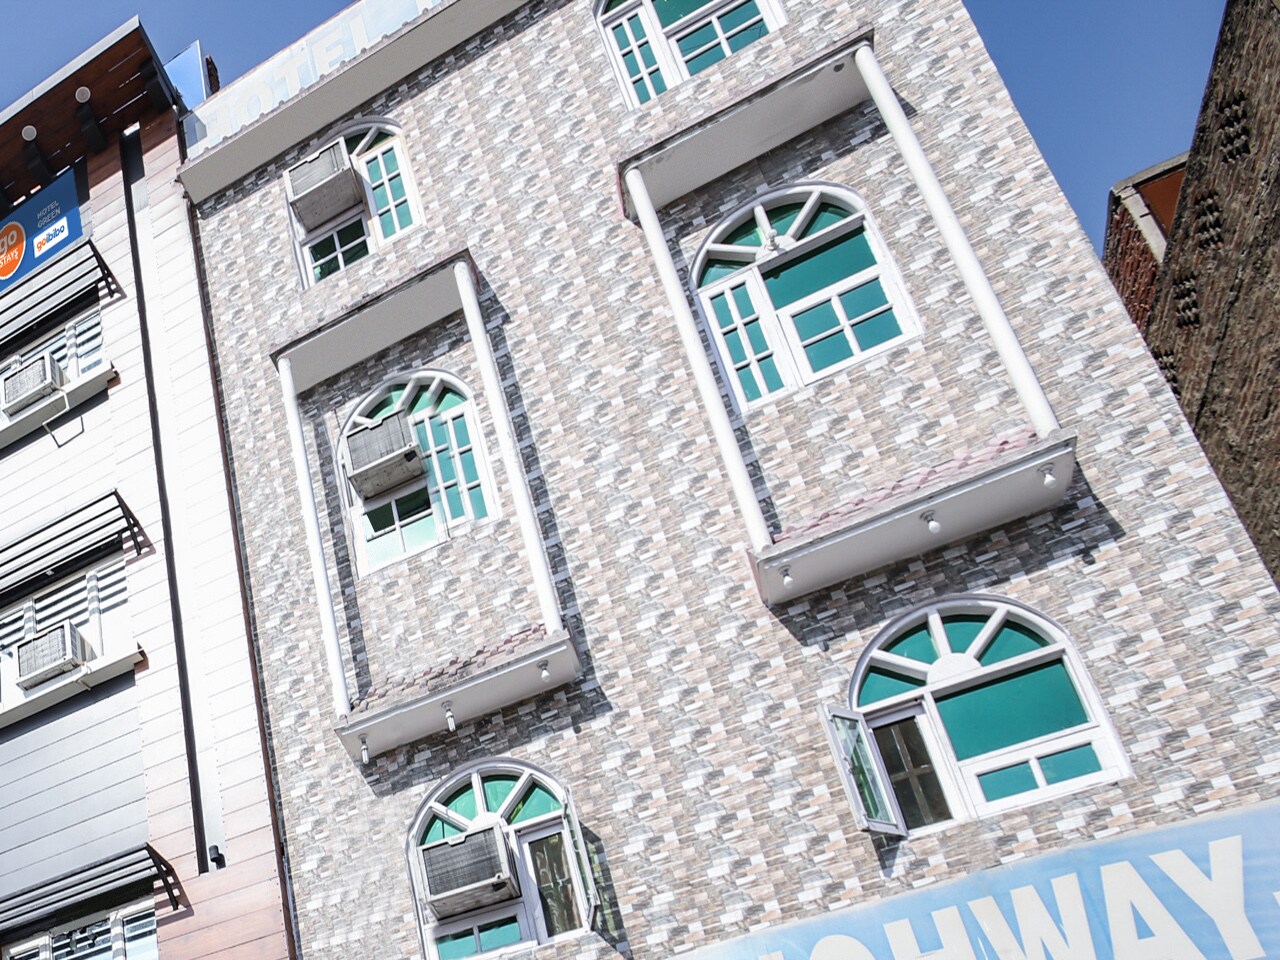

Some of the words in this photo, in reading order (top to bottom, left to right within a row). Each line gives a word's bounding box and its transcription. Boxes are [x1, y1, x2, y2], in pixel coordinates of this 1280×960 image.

[37, 200, 60, 219] HOTEL
[37, 208, 61, 228] GREEN
[36, 223, 65, 252] goibibo
[0, 248, 19, 268] STAYS
